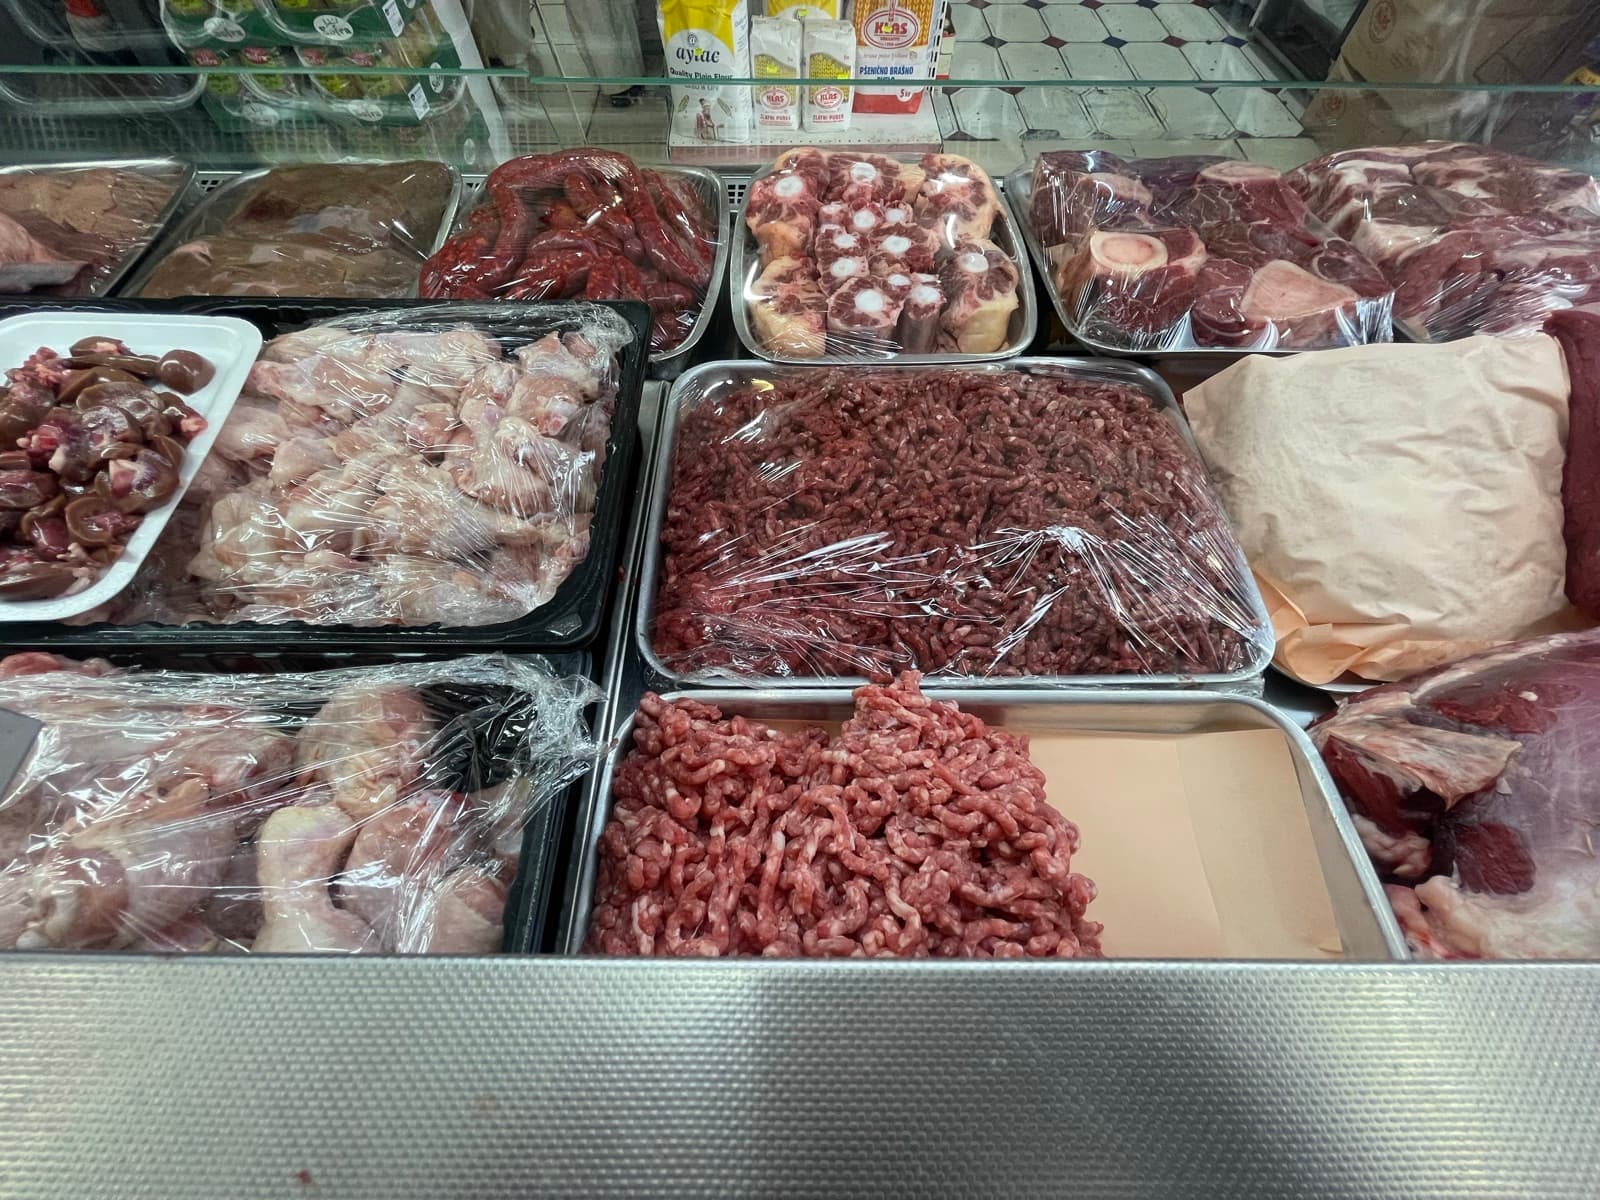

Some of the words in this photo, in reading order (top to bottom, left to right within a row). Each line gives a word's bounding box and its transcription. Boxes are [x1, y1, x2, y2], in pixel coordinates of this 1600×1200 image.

[669, 67, 693, 79] Quality
[694, 72, 712, 80] Plain
[890, 65, 914, 75] BRAŠNO
[900, 88, 905, 98] 5
